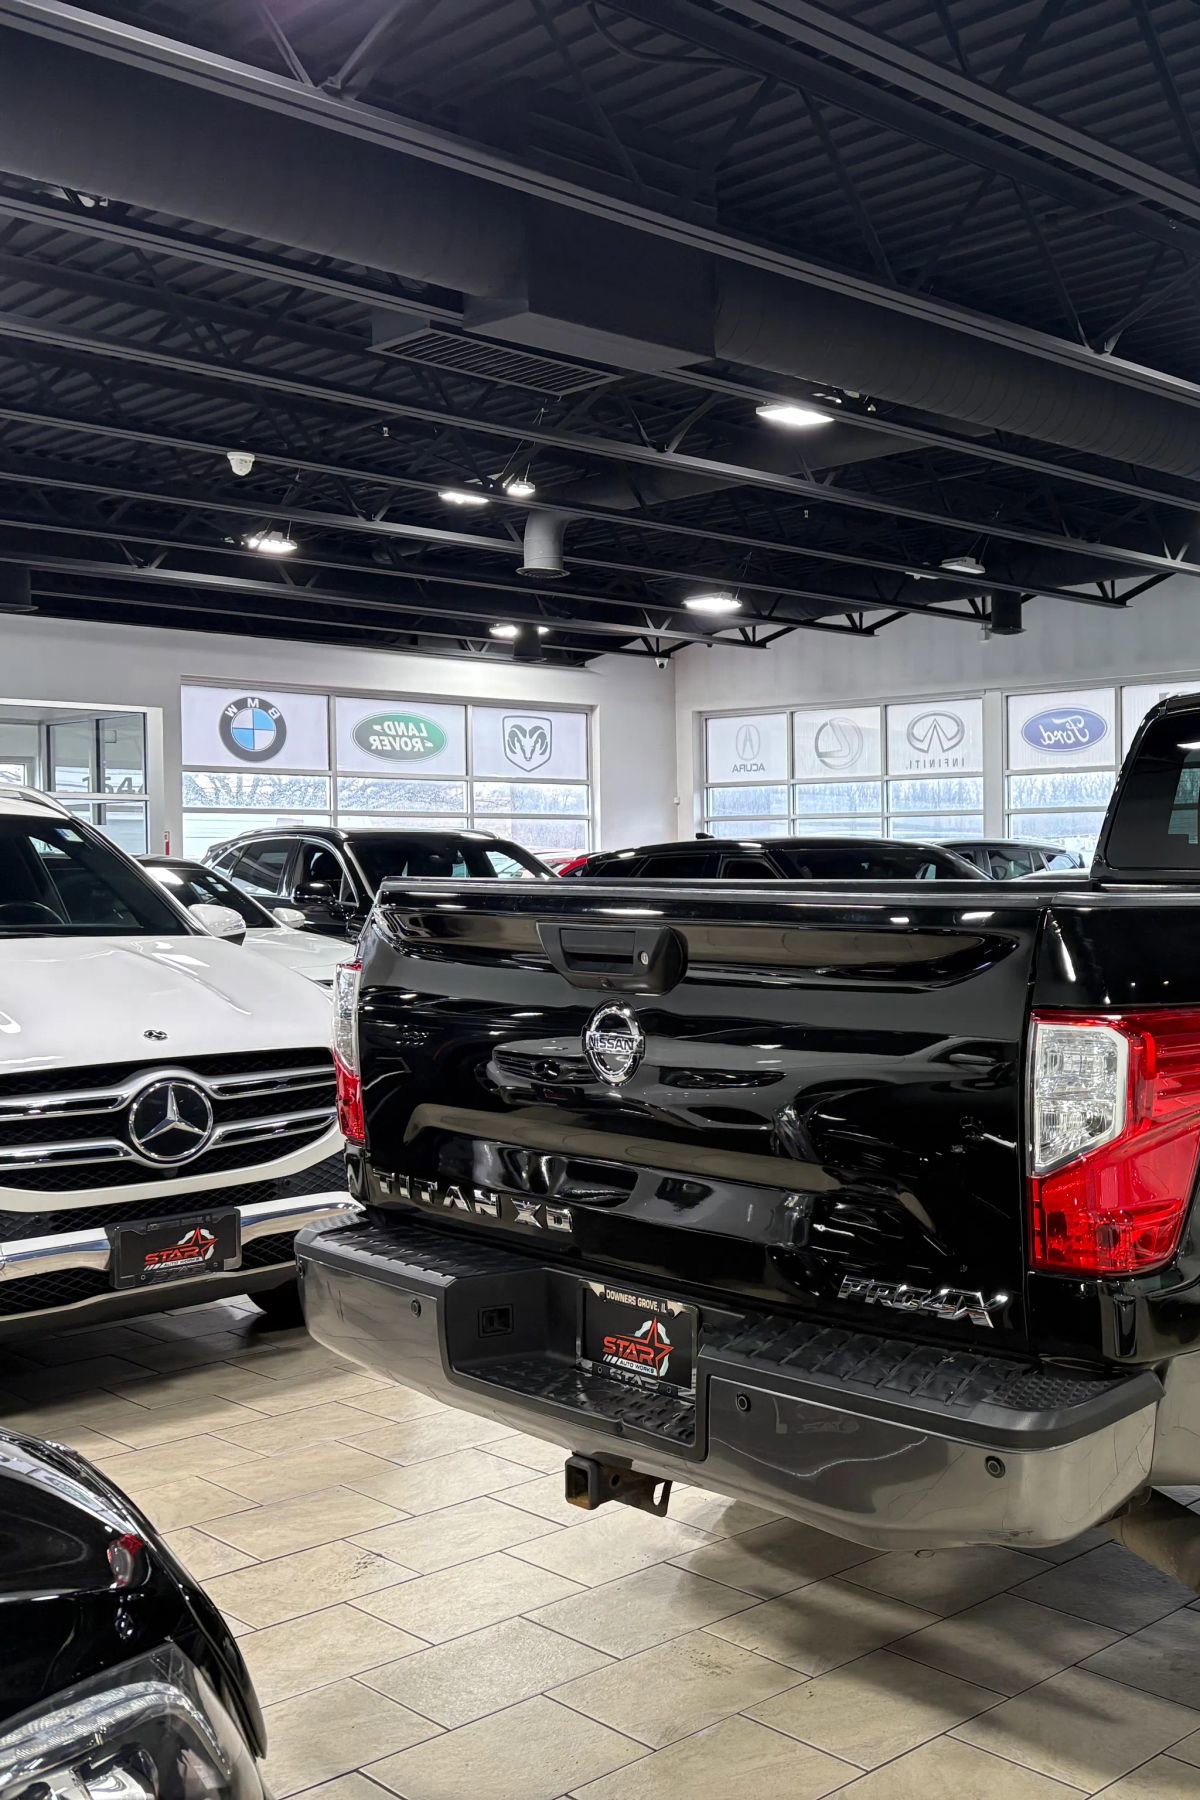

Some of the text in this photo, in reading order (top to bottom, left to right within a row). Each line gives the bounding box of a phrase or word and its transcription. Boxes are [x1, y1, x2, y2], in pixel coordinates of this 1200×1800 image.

[81, 776, 144, 794] 154
[588, 1034, 635, 1051] NISSAN
[372, 1167, 574, 1233] TITAN XD
[144, 1245, 200, 1265] STAR
[606, 1290, 667, 1313] DOWNERS GROVE, IL
[603, 1337, 654, 1365] STAR
